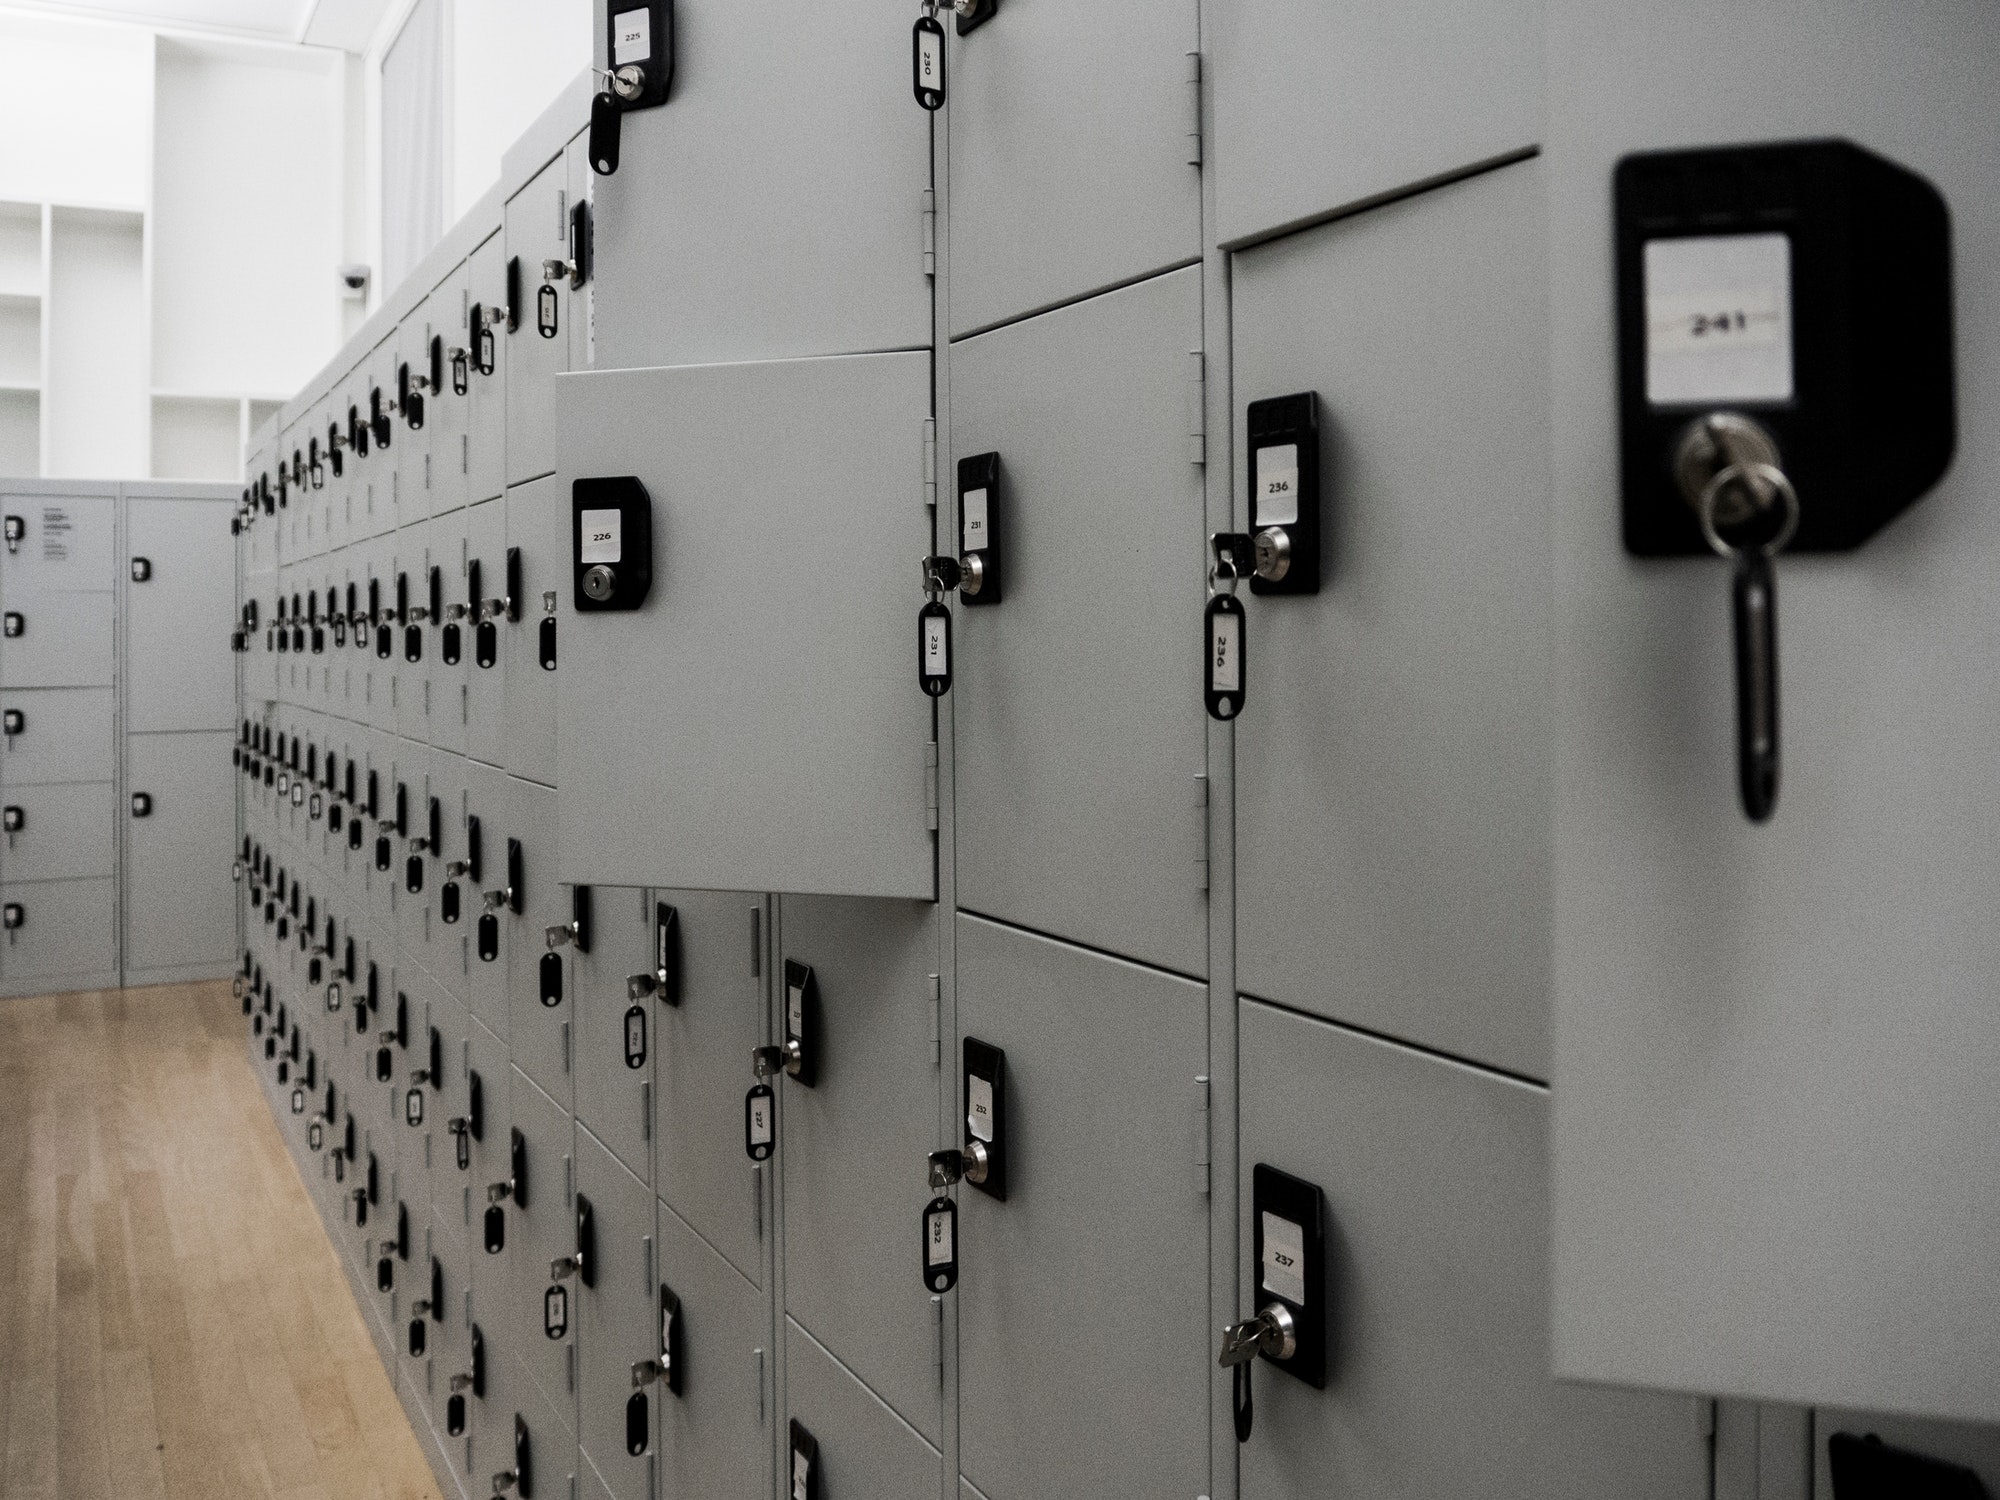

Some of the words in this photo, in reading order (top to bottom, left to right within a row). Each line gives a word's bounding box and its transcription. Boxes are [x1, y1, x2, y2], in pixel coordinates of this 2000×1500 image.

[625, 32, 641, 42] 225
[923, 52, 931, 76] 230
[1691, 312, 1746, 337] 241
[1268, 480, 1289, 494] 236
[970, 520, 982, 530] 231
[593, 532, 612, 542] 226
[930, 635, 939, 656] 231
[1217, 636, 1227, 668] 236
[975, 1103, 987, 1115] 232
[754, 1111, 764, 1129] 227
[933, 1221, 943, 1245] 232
[1274, 1251, 1295, 1269] 237
